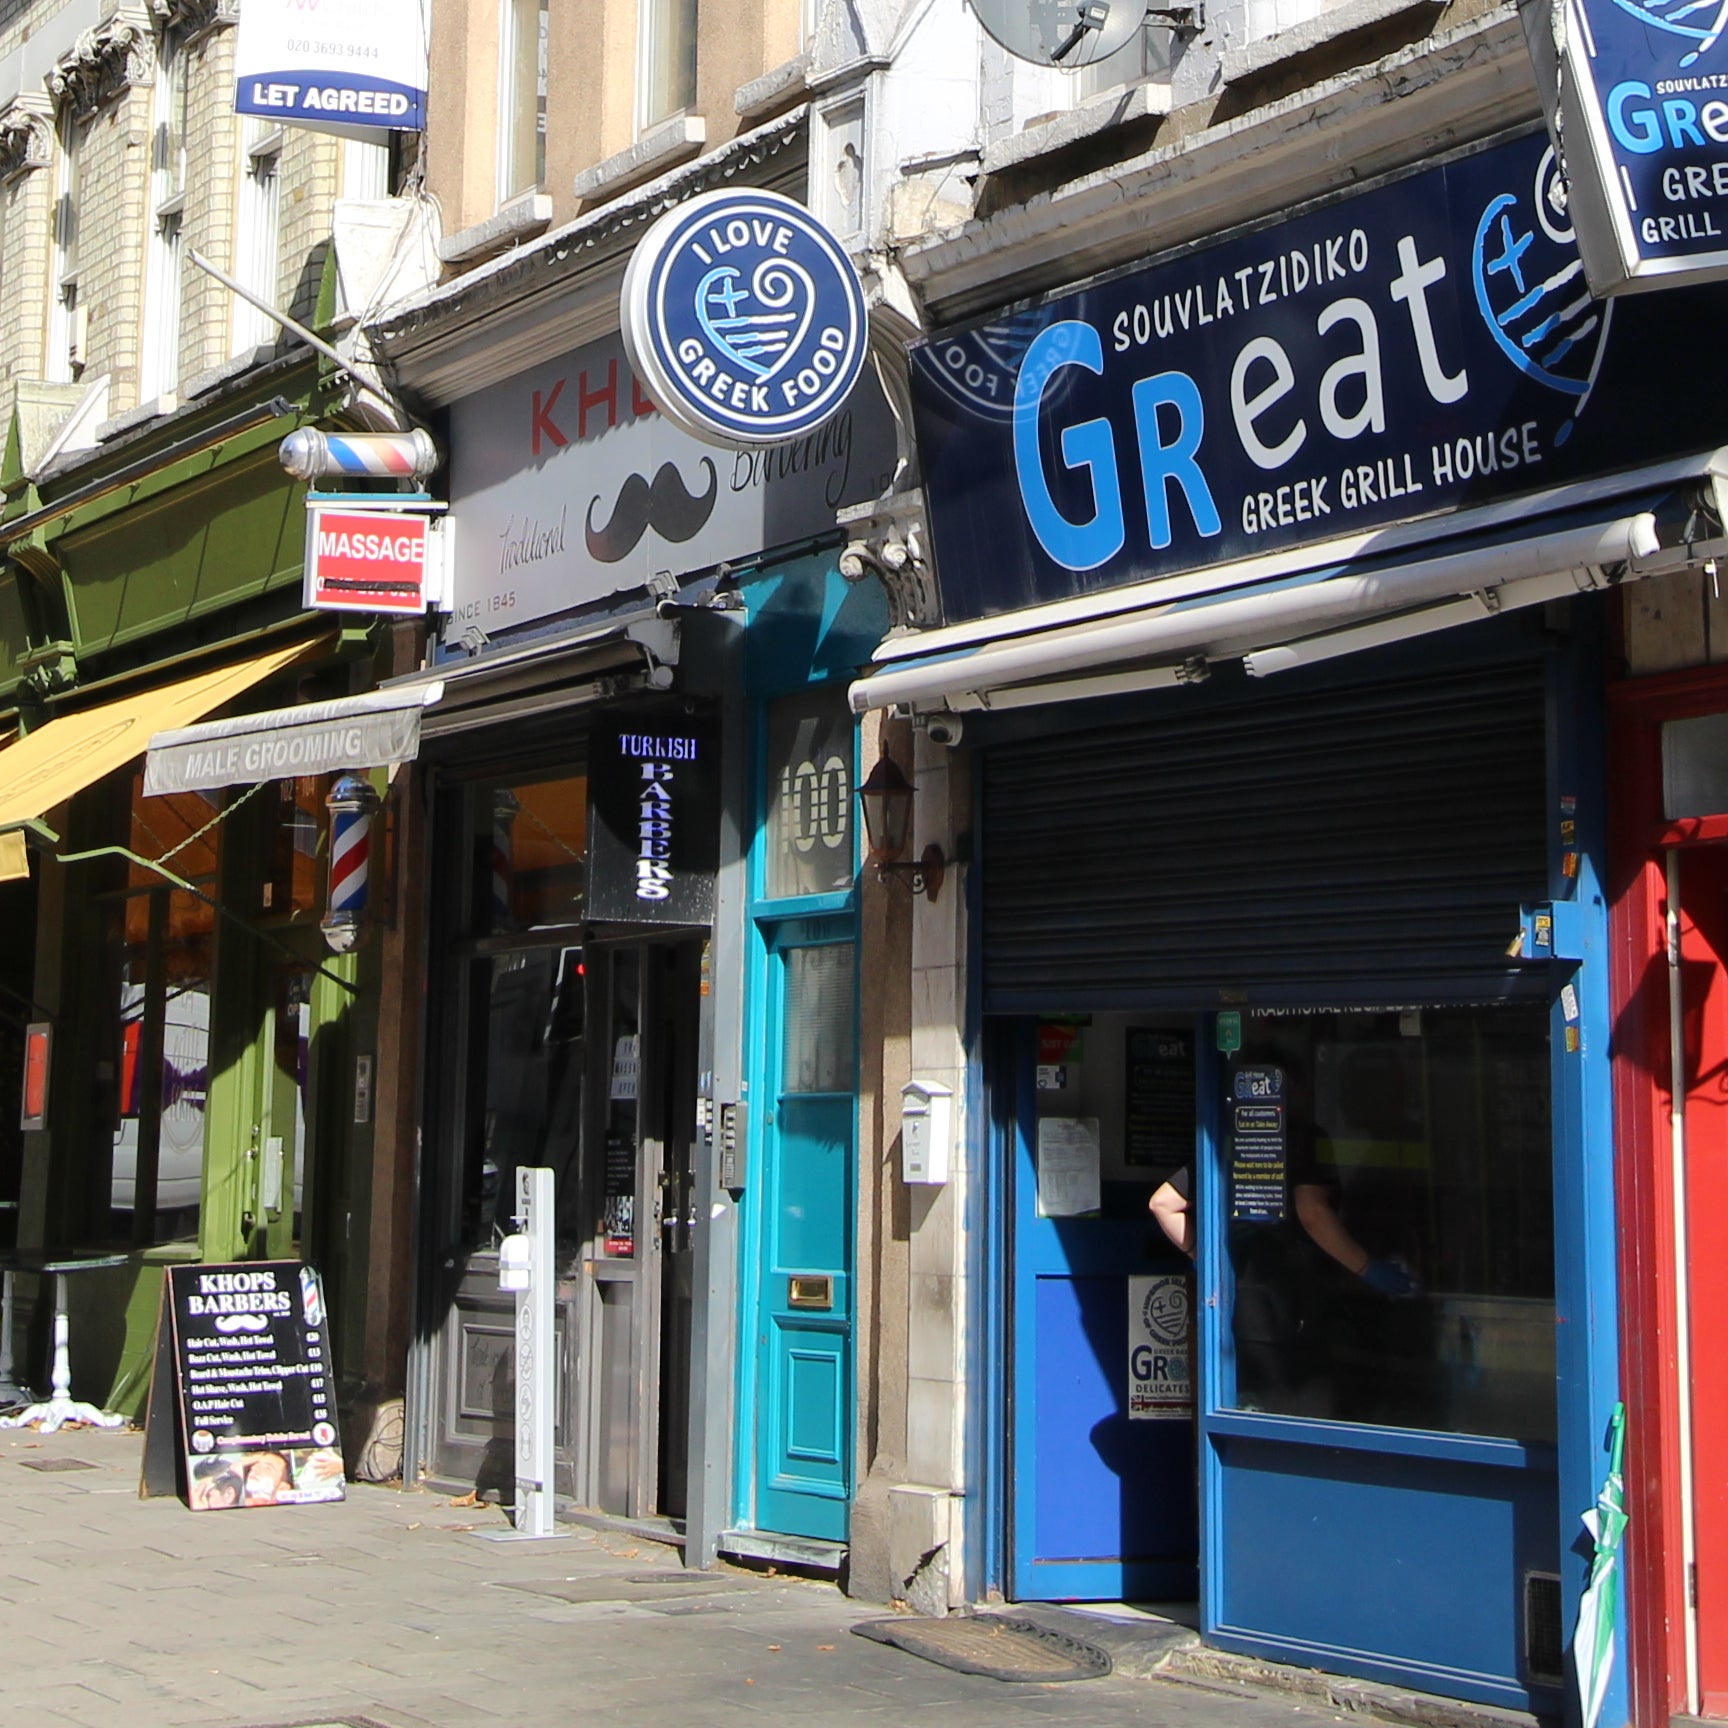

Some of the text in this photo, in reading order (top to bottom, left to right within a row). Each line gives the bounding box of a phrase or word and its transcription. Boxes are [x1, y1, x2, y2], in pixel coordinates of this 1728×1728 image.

[287, 38, 379, 59] 020 3693 9444
[253, 82, 408, 116] LET AGREED
[691, 219, 793, 265] I LOVE
[1640, 210, 1721, 244] GRILL
[1113, 228, 1370, 353] SOUVLATZIDIKO
[678, 327, 845, 412] GREEK FOOD
[1242, 420, 1543, 535] GREEK GRILL HOUSE
[319, 531, 425, 563] MASSAGE
[447, 591, 516, 624] SINCE 1845
[184, 728, 362, 780] MALE GROOMING
[619, 734, 696, 760] TURKISH
[782, 755, 847, 854] 100
[199, 1271, 277, 1293] KHOPS
[188, 1291, 291, 1315] BARBERS
